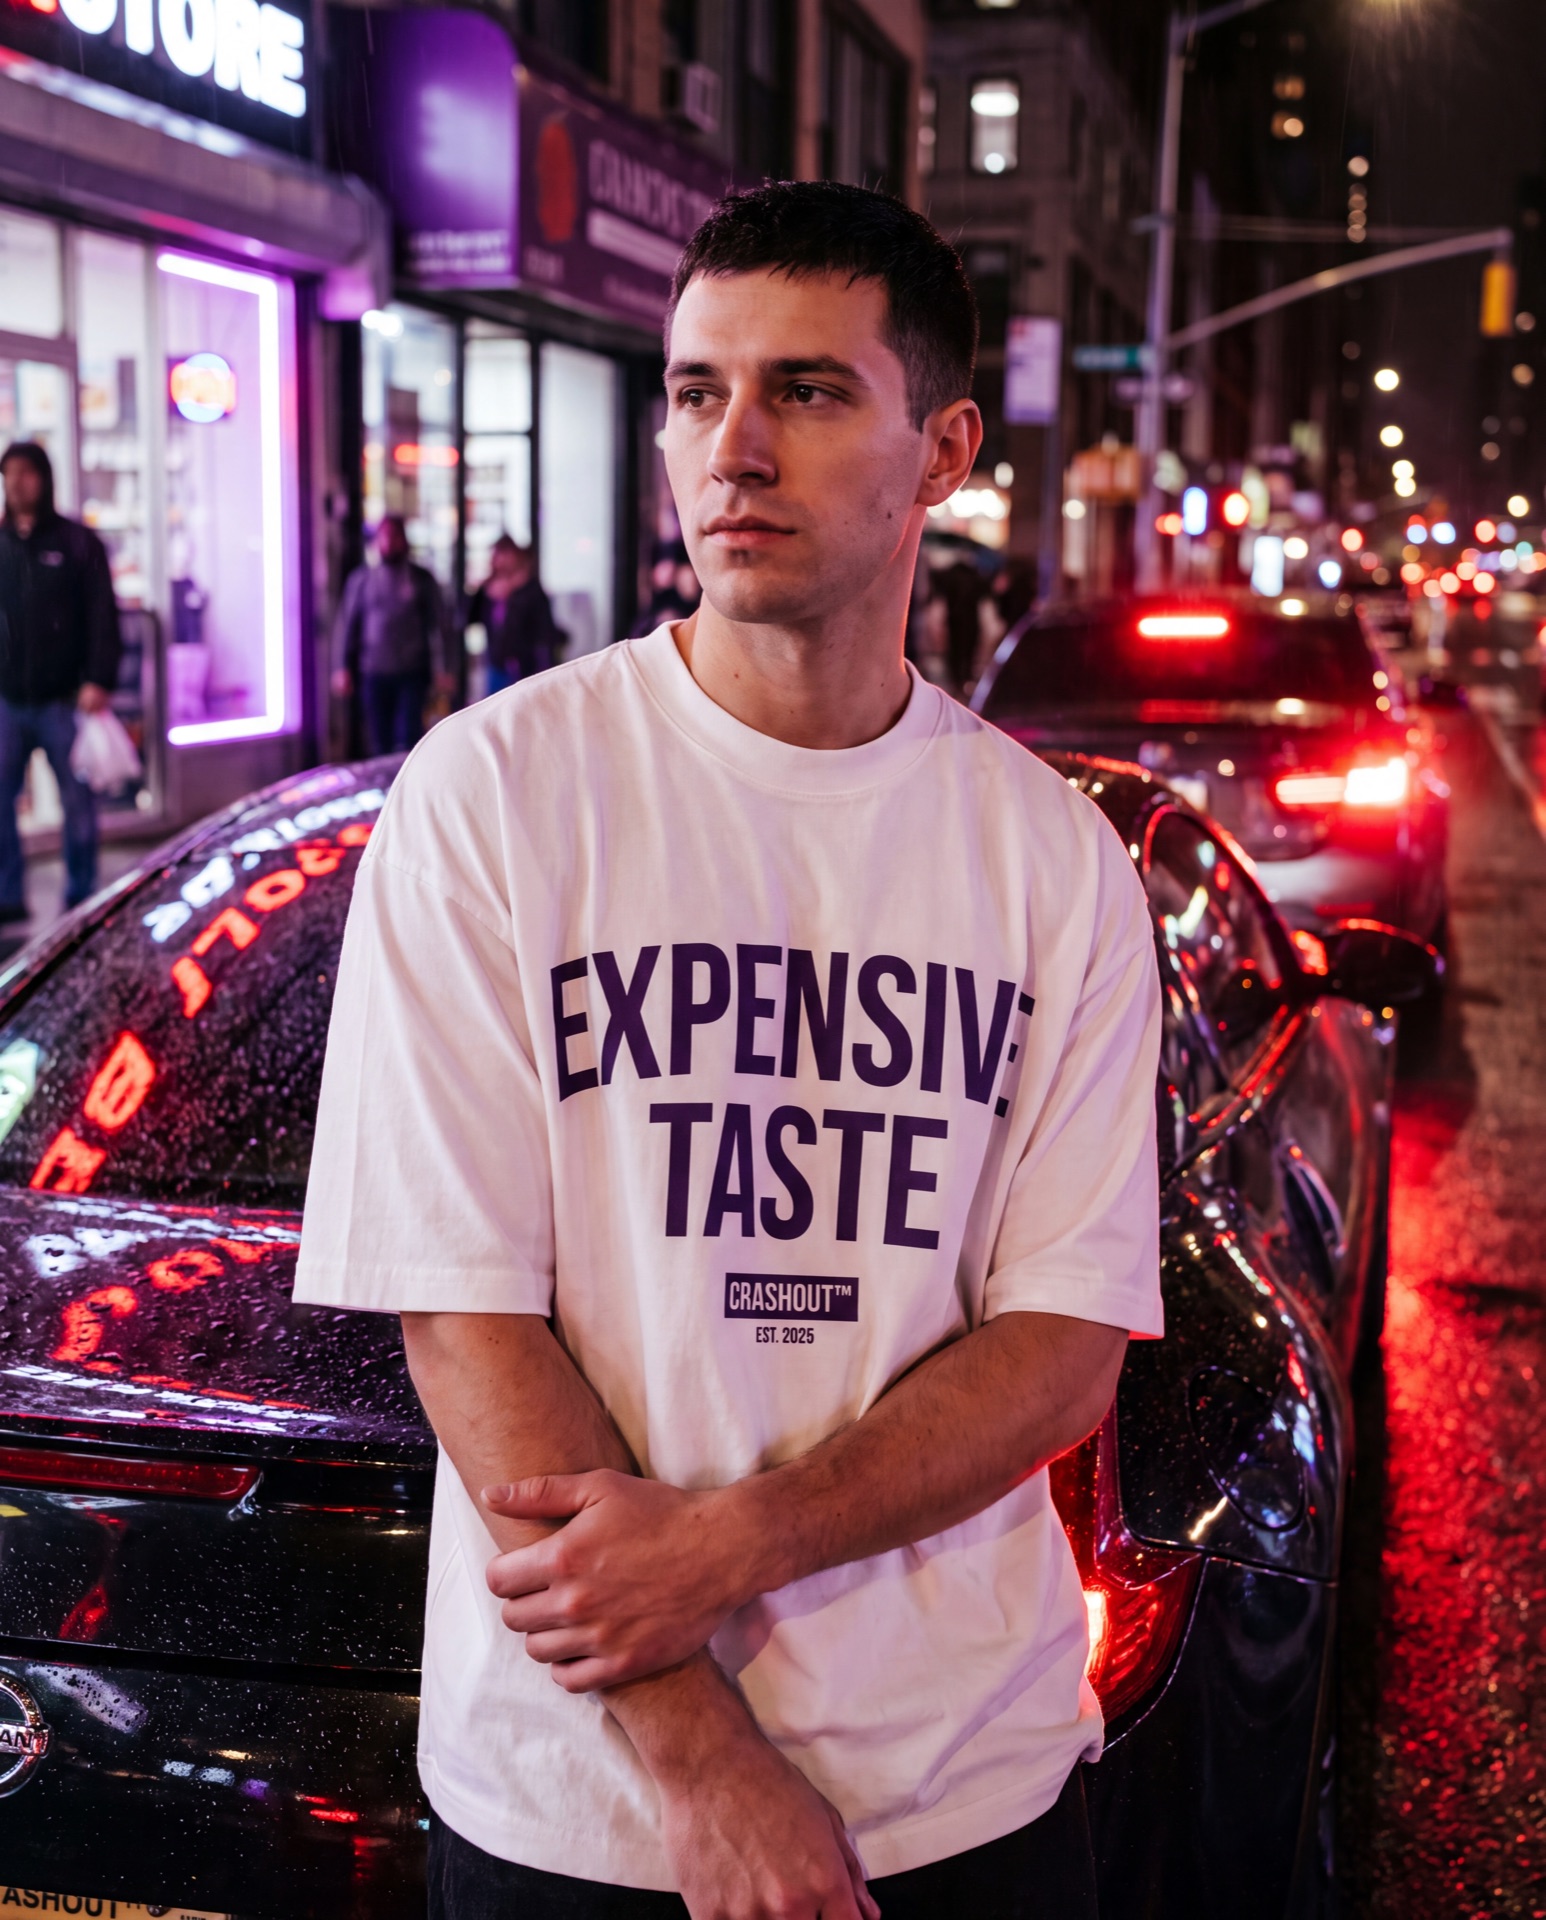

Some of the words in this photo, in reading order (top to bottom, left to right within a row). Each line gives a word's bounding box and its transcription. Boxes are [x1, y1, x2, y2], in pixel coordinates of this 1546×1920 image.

[649, 1102, 949, 1250] TASTE
[756, 1326, 779, 1344] EST.
[782, 1327, 815, 1344] 2025
